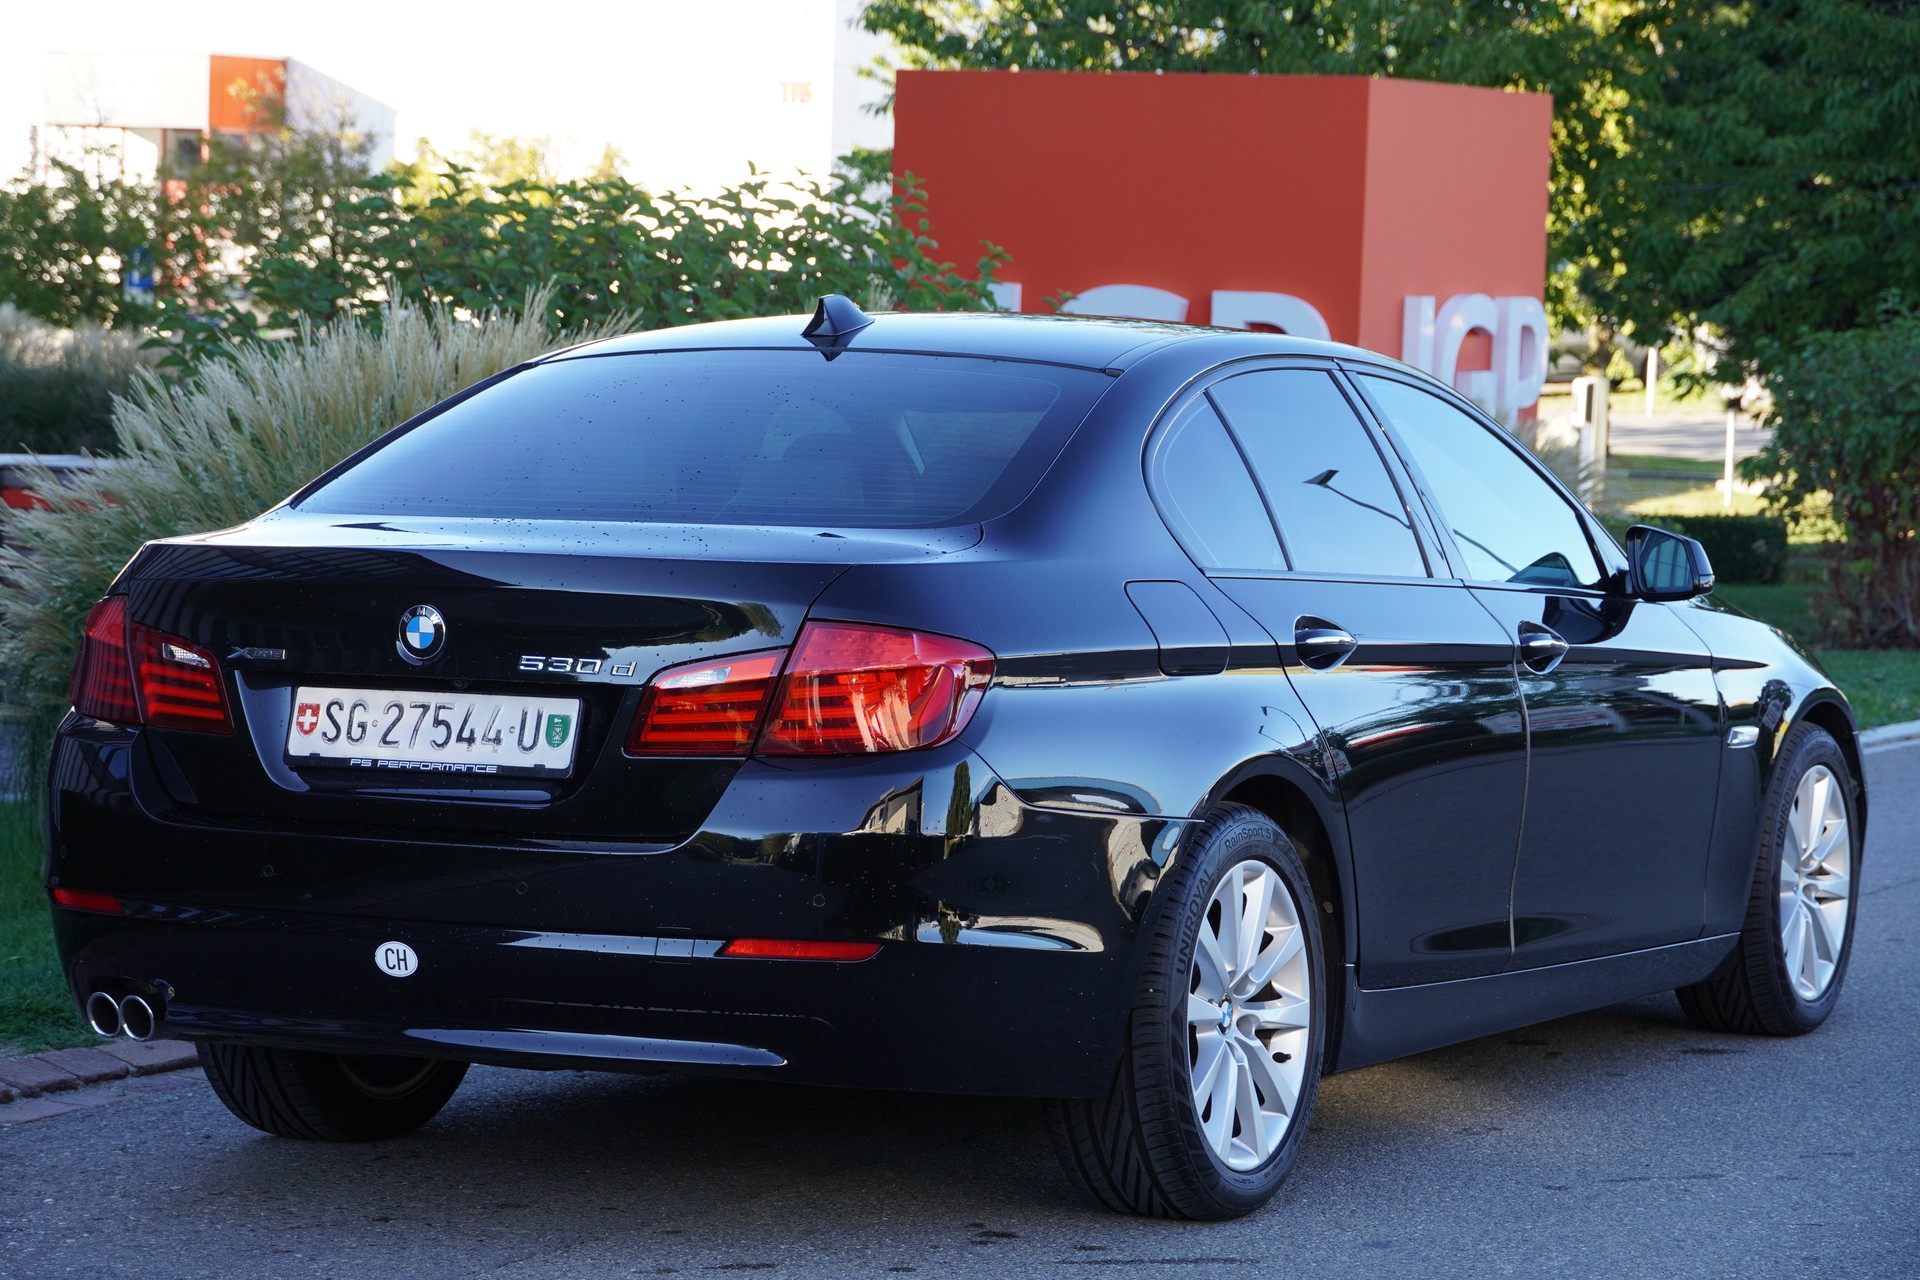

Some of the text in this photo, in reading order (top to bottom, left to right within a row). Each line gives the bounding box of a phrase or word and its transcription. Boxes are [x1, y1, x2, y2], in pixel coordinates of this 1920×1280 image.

[403, 606, 441, 625] BMW
[519, 655, 603, 675] 530
[350, 758, 498, 774] PS PERFORMANCE
[1224, 827, 1272, 852] RainSport 5
[1176, 869, 1214, 976] UNIROYAL
[384, 947, 409, 971] CH
